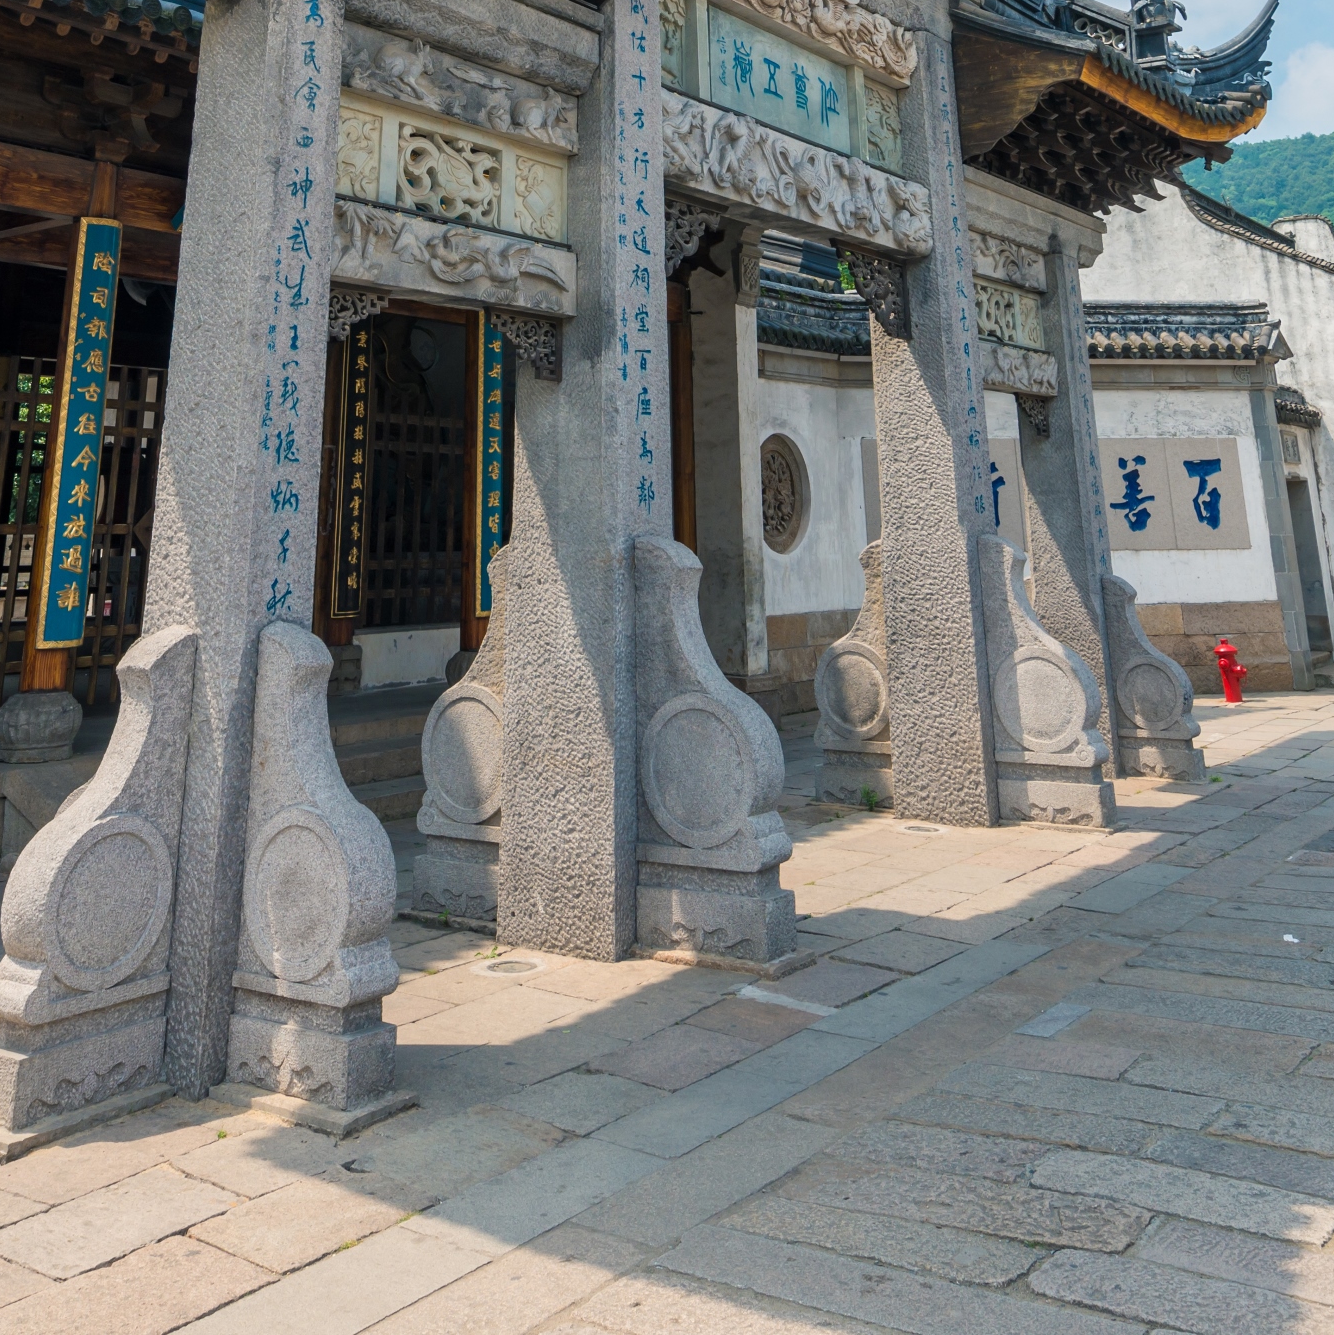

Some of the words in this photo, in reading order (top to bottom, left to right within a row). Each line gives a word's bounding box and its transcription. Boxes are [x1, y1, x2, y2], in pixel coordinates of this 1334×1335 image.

[487, 325, 502, 558] 世奸雄違天害理皆由
[1109, 454, 1222, 533] 百善
